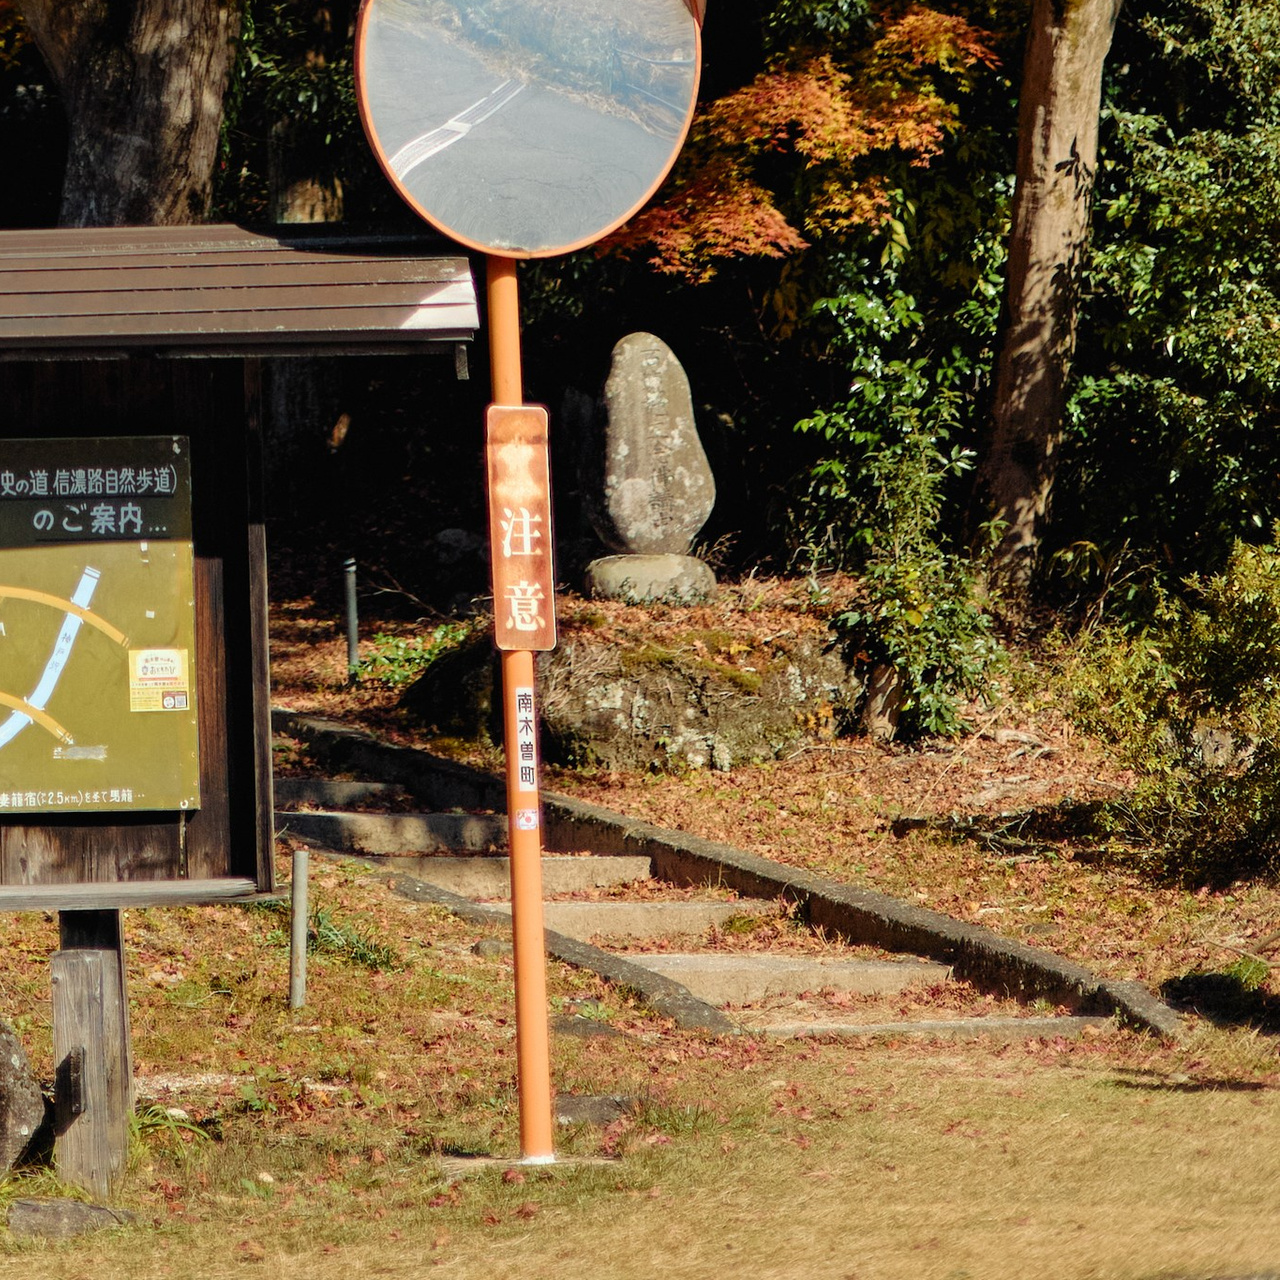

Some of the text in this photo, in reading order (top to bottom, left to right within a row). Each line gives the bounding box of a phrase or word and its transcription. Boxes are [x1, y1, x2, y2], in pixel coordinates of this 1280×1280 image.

[500, 506, 546, 632] 注意
[517, 692, 535, 785] 南木曽町
